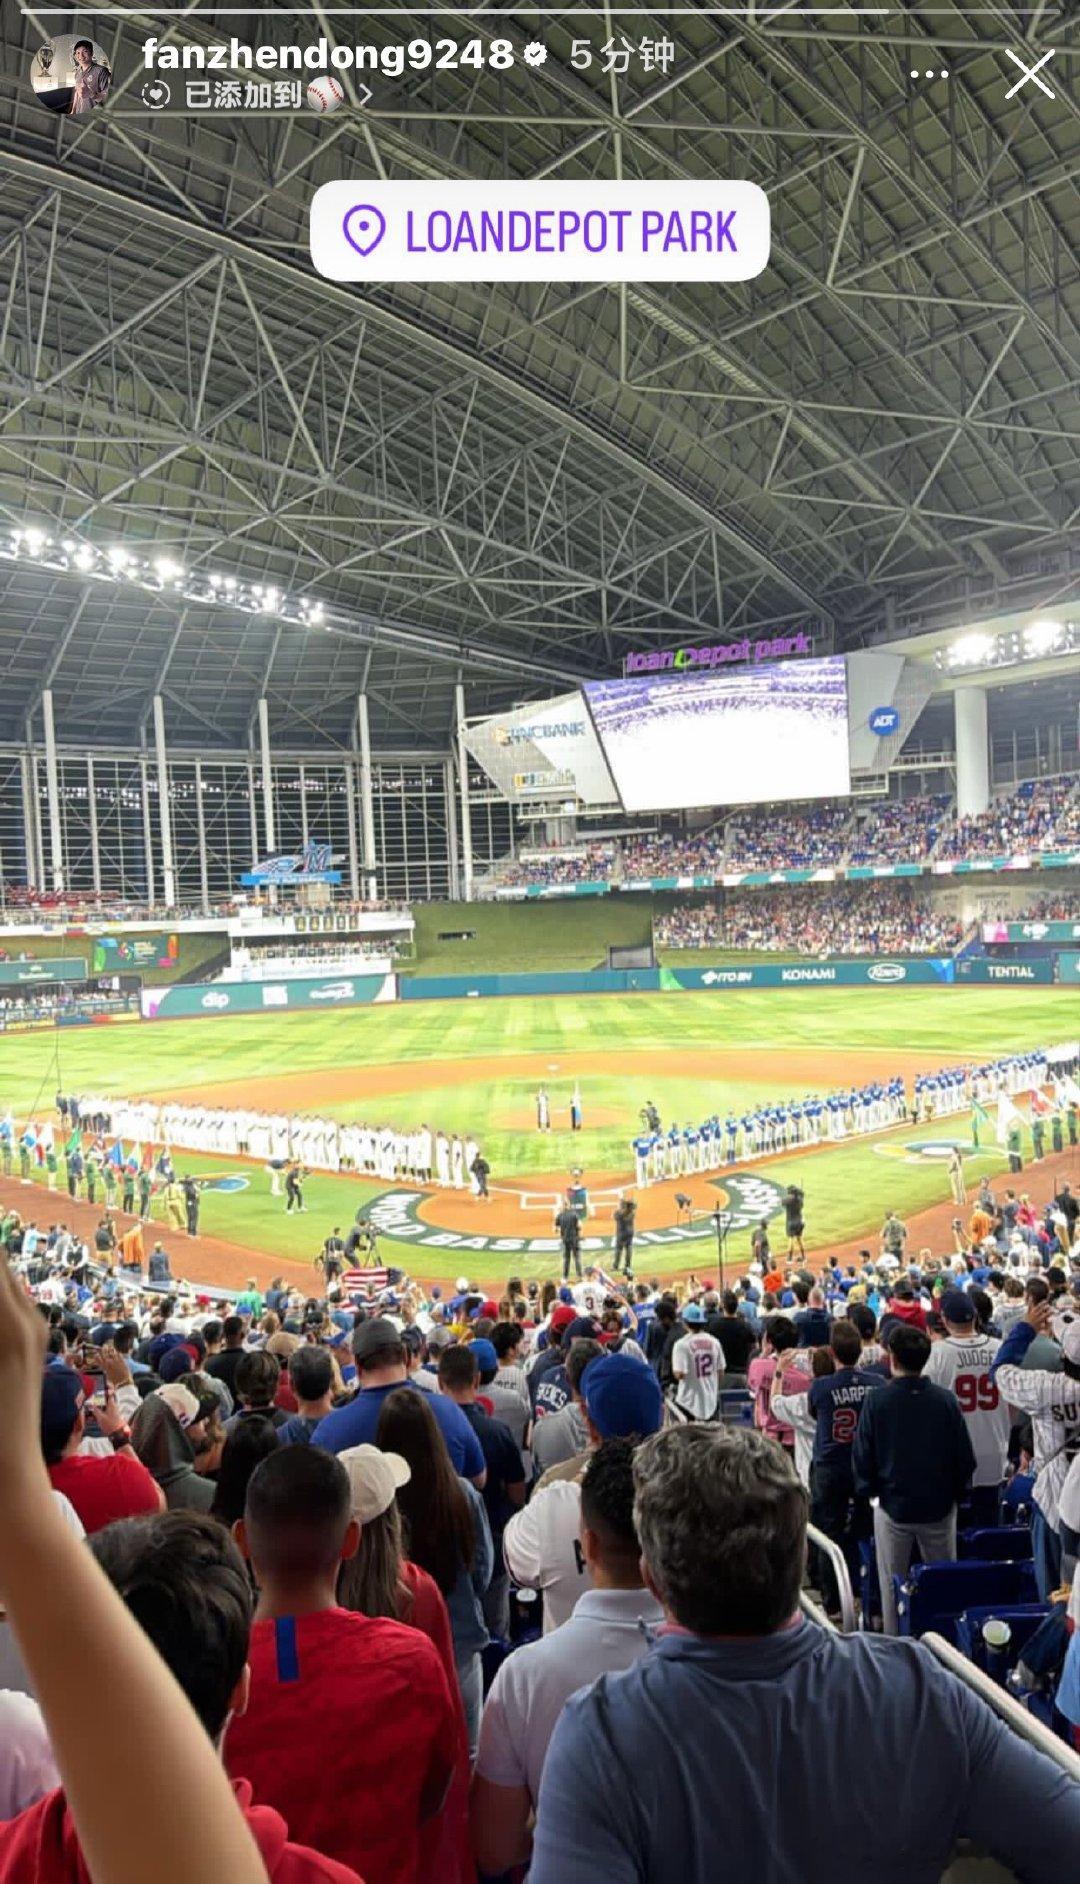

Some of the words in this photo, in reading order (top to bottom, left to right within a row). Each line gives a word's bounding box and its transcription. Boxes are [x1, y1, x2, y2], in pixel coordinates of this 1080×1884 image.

[755, 632, 809, 660] park
[782, 968, 835, 980] KONAMI
[987, 965, 1035, 978] TENTIAL
[368, 1193, 427, 1236] WORLD
[695, 1353, 713, 1378] 12
[831, 1385, 877, 1406] HARP
[955, 1373, 999, 1413] 99
[1051, 1403, 1080, 1422] SU
